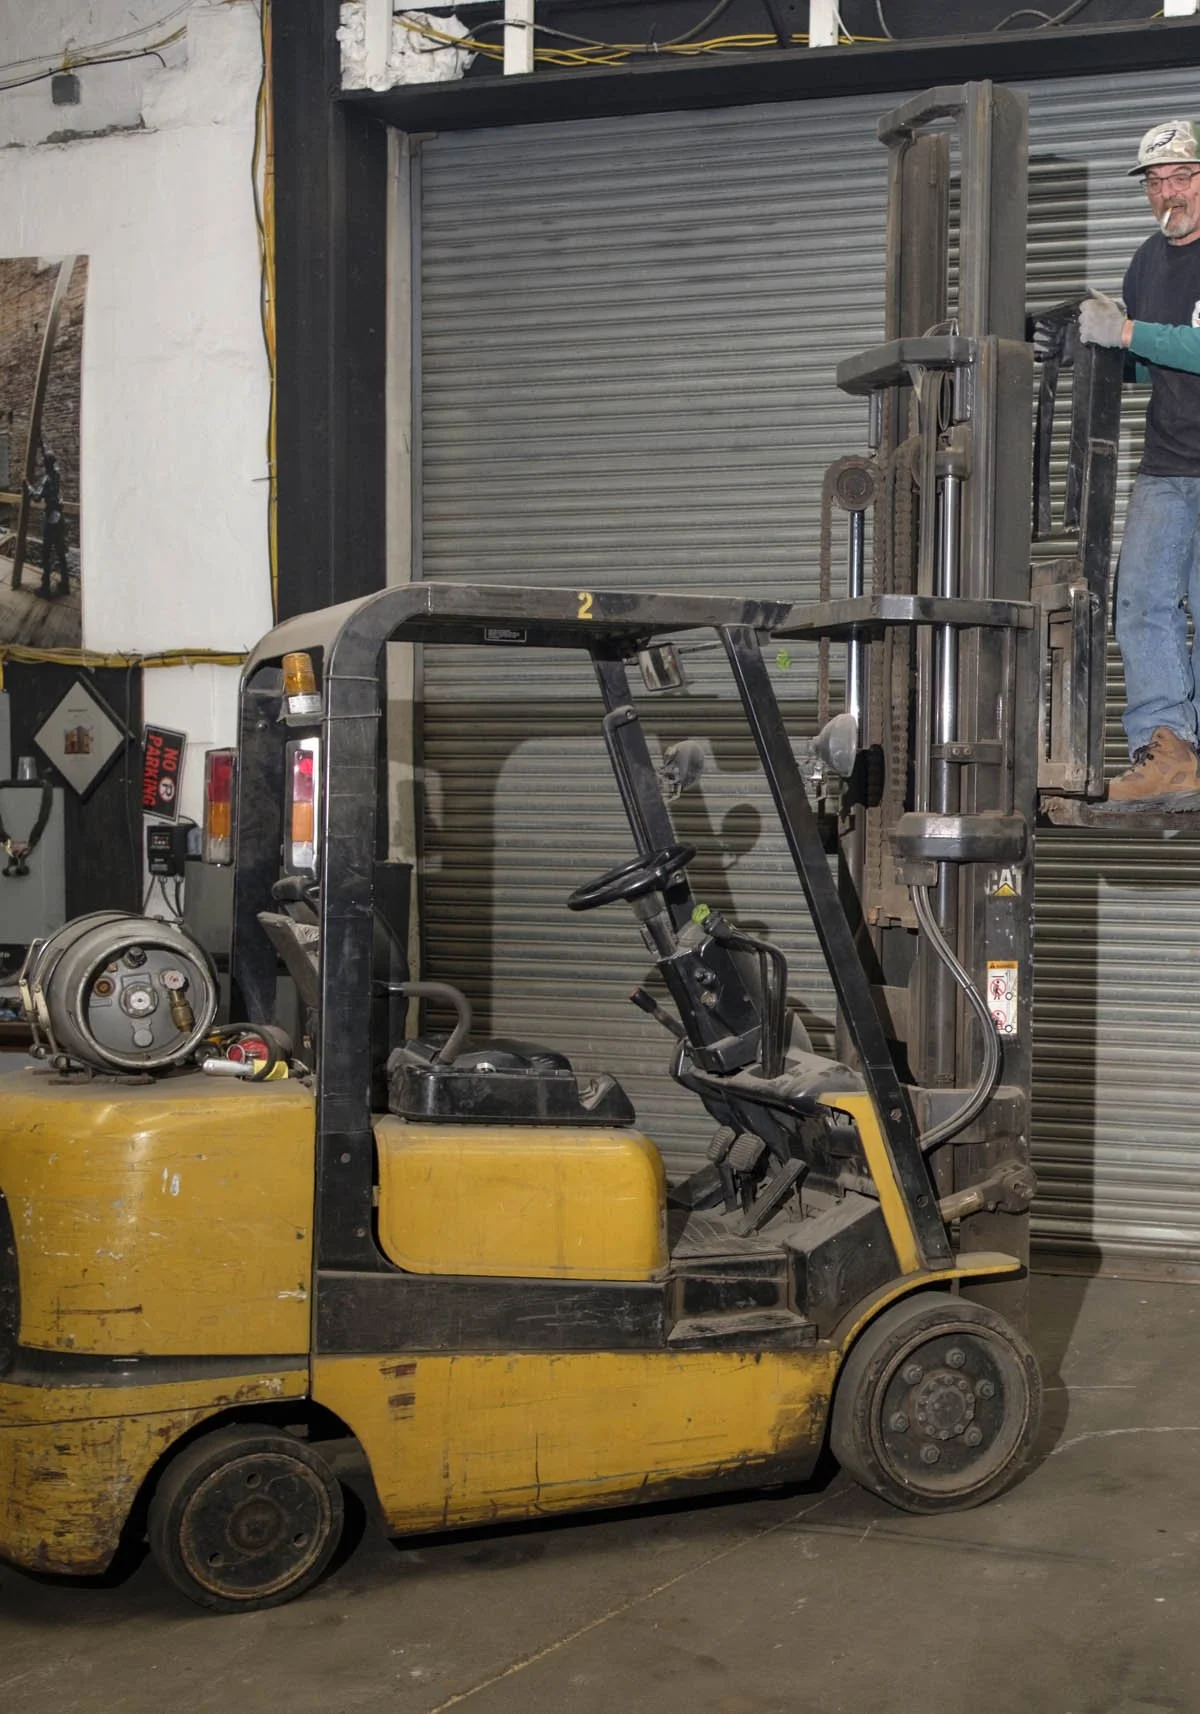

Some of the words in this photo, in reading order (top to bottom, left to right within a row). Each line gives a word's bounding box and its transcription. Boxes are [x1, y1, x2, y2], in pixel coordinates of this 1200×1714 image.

[578, 592, 593, 618] 2
[144, 734, 163, 806] PARKING
[163, 748, 178, 771] NO
